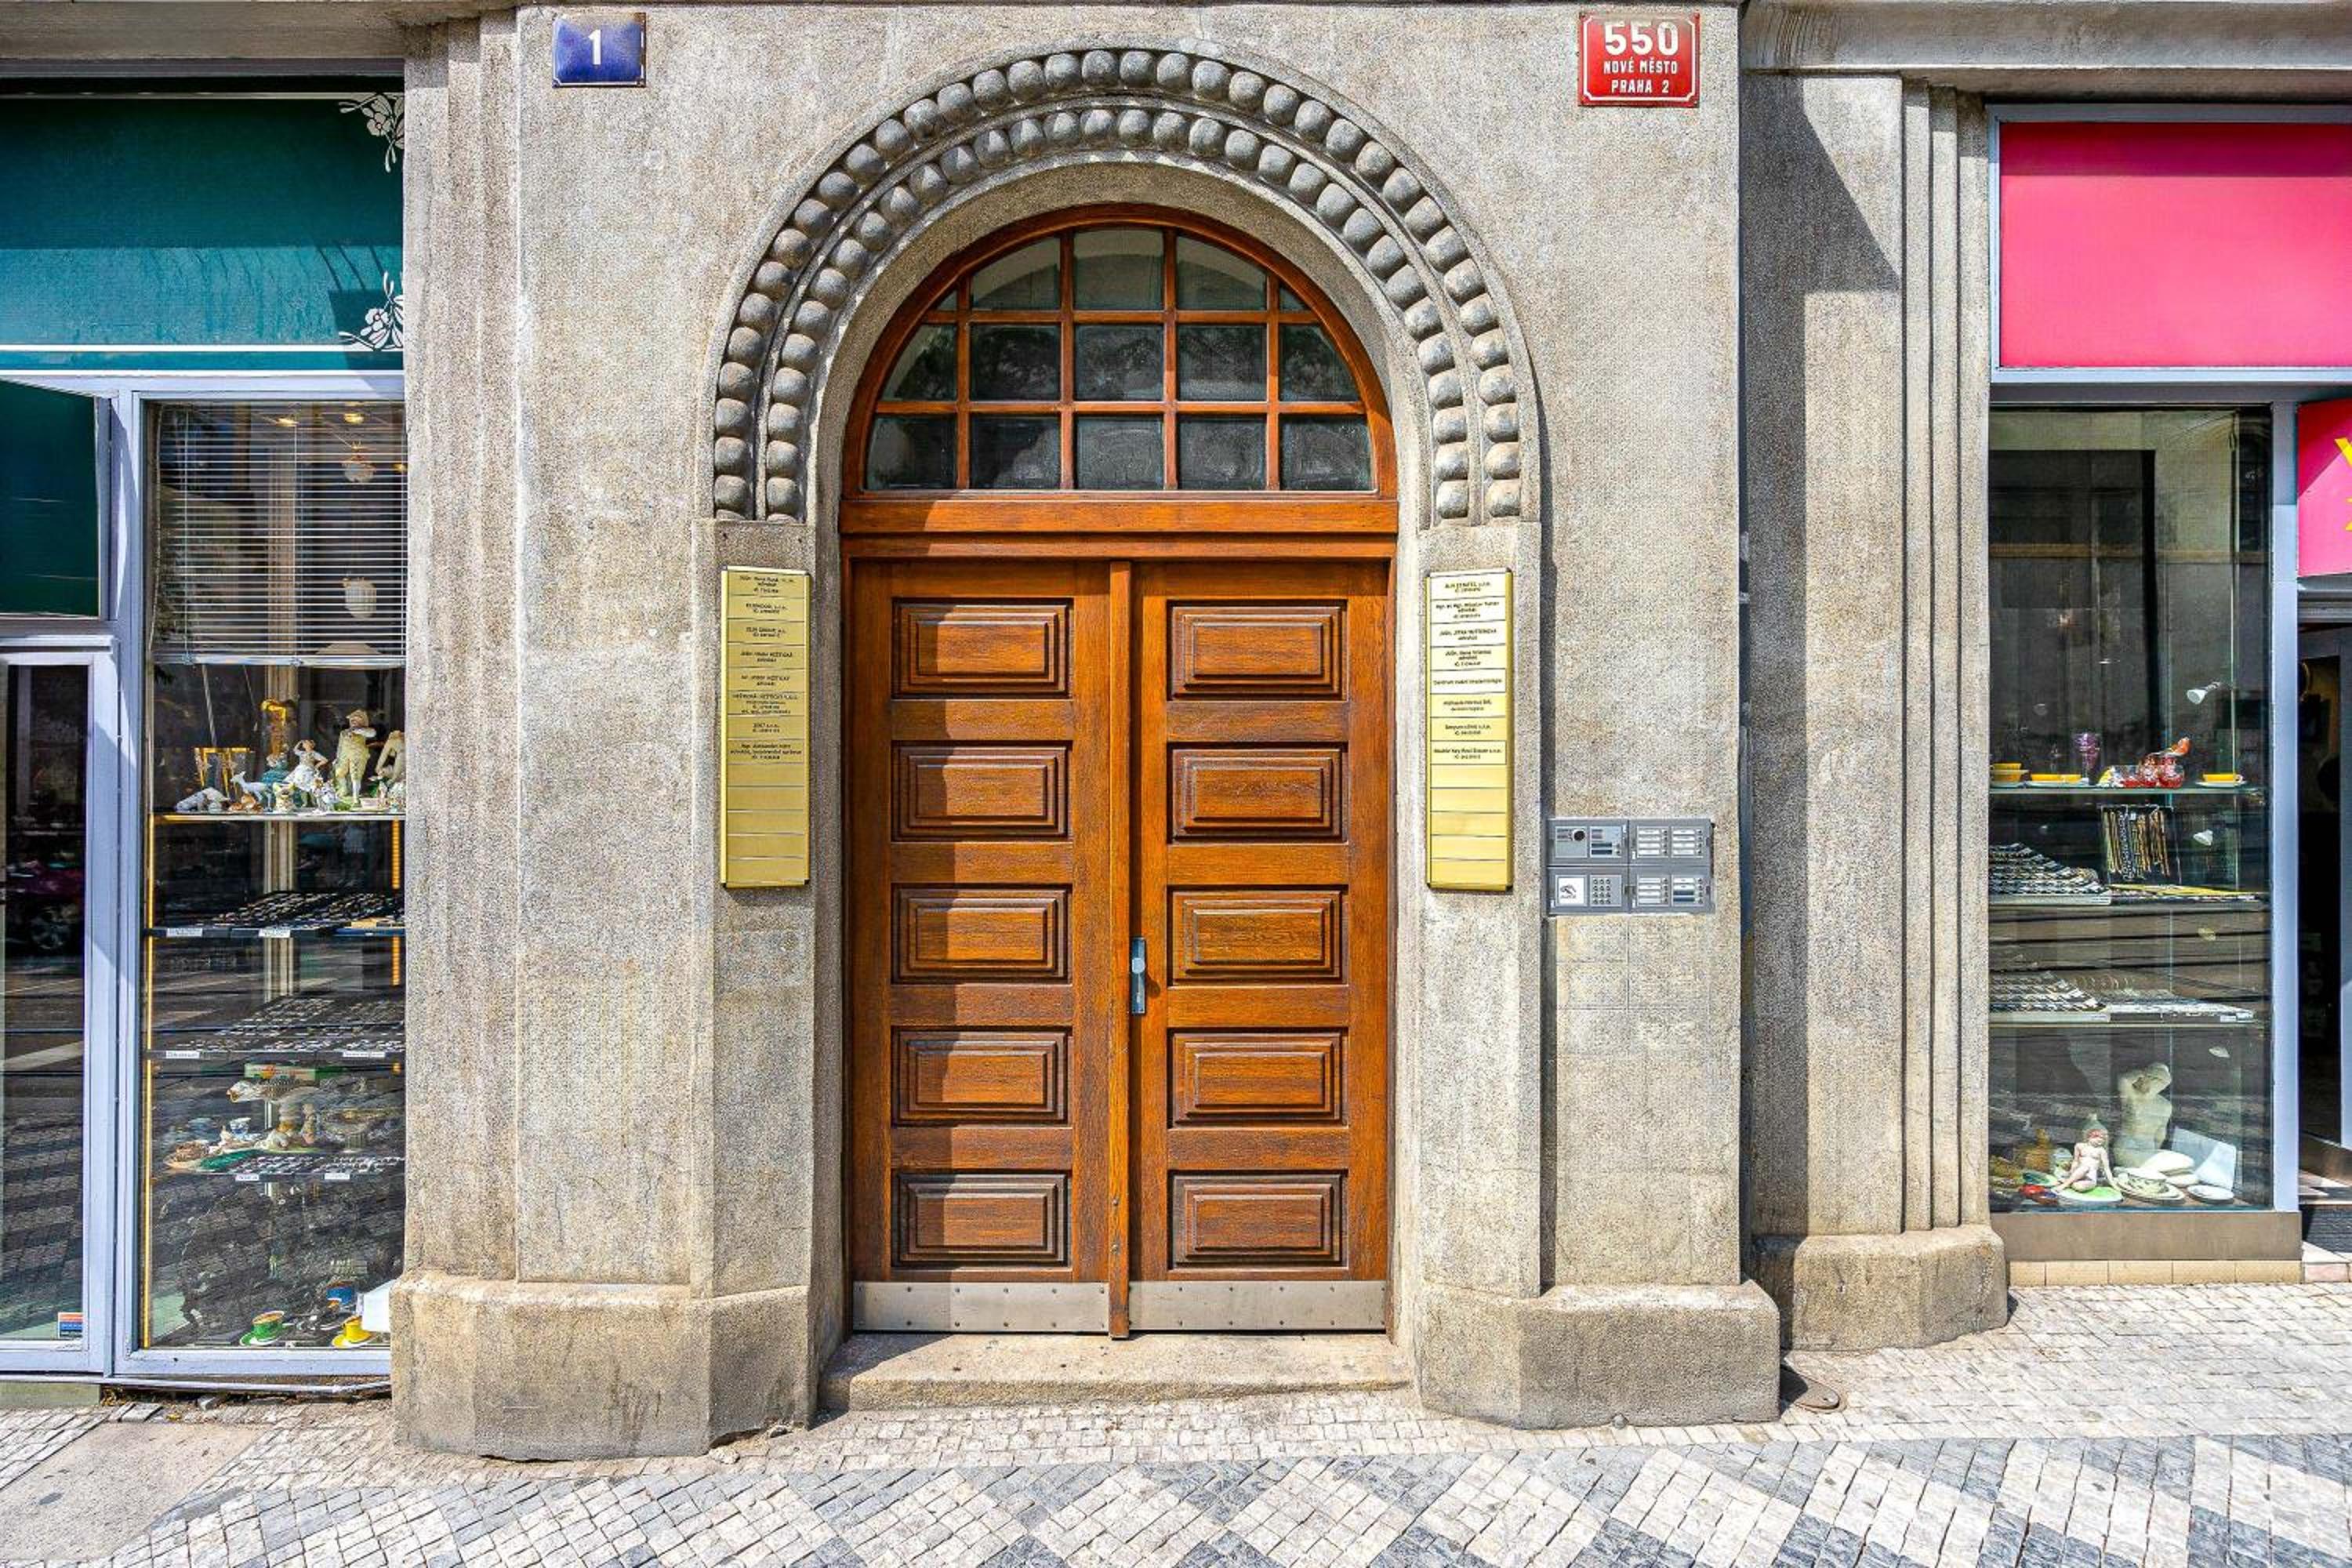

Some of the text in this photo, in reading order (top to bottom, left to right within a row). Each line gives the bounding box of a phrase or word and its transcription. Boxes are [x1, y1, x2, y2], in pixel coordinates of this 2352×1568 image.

[588, 29, 601, 65] 1
[1604, 21, 1679, 56] 550
[1603, 56, 1678, 74] NOVÉ MĚSTO
[1611, 79, 1669, 93] PRAHA 2
